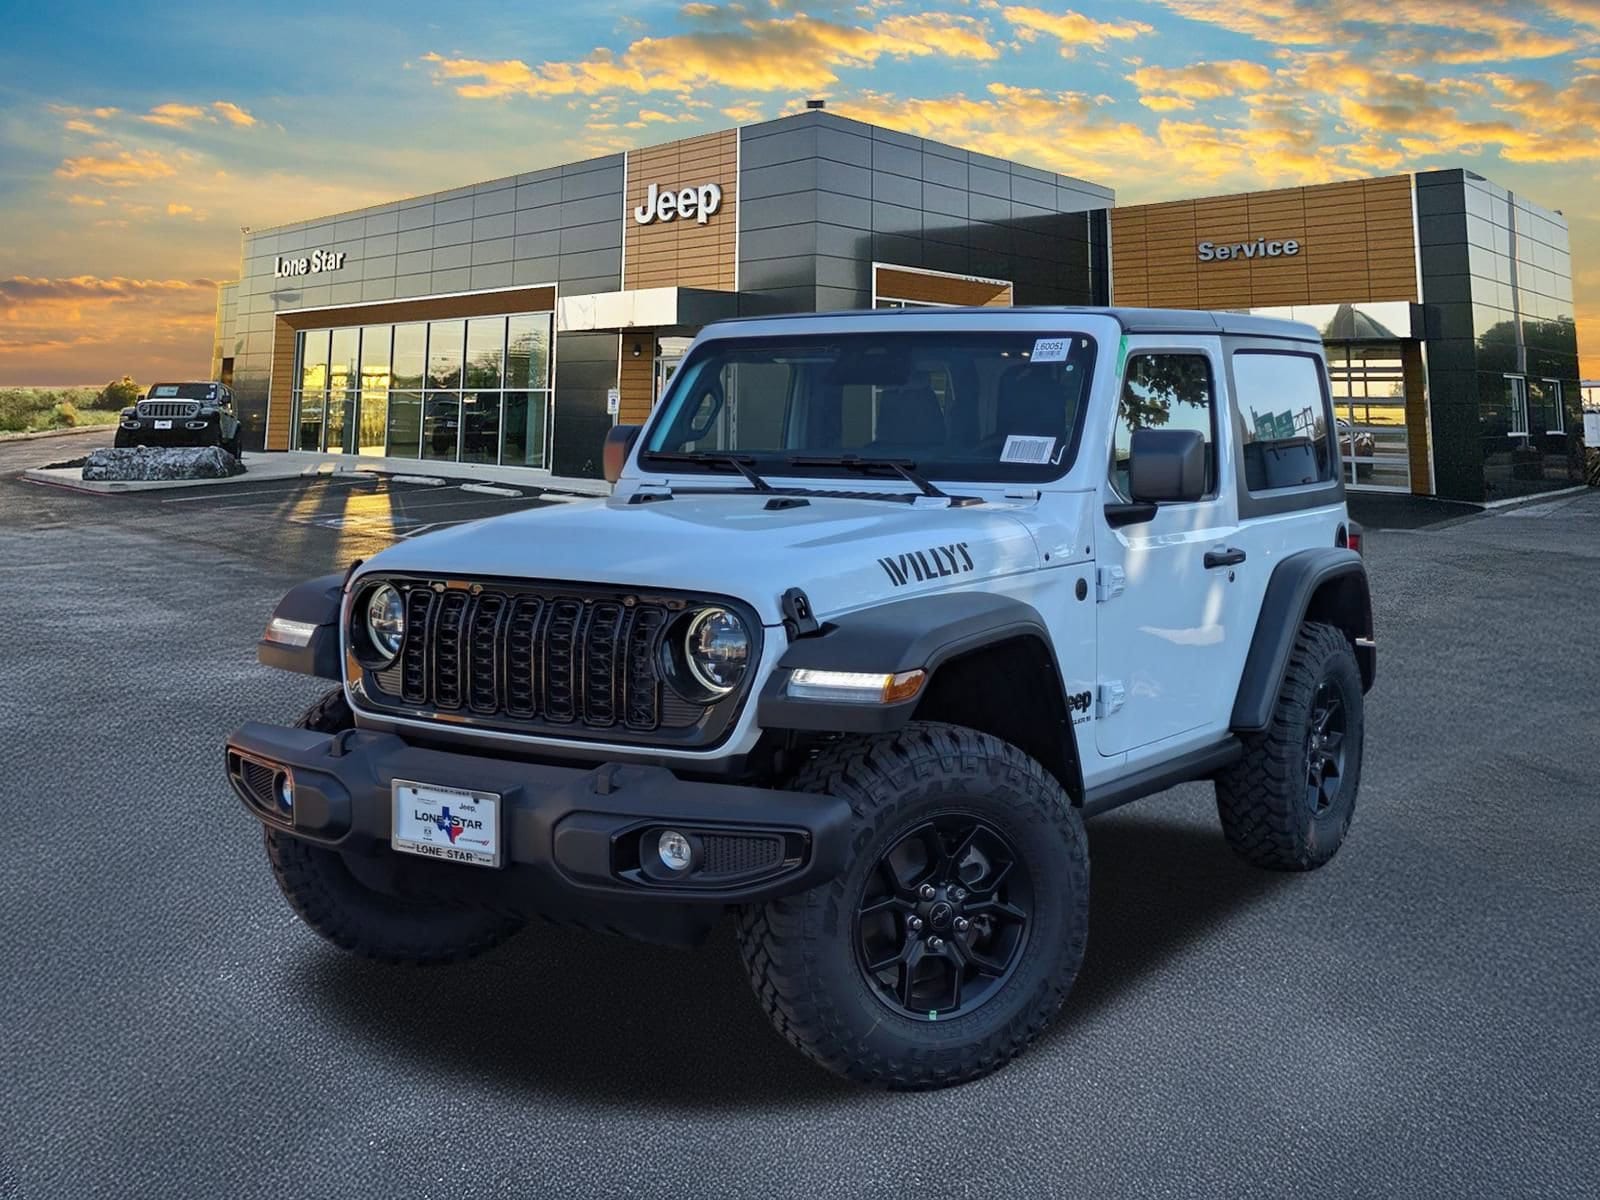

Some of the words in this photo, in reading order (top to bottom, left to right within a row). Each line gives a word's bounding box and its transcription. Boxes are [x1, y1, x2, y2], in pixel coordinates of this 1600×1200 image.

[634, 182, 722, 225] Jeep
[1198, 237, 1300, 261] Service
[274, 256, 309, 278] Lone
[311, 249, 346, 273] Star
[877, 542, 974, 587] WILLYS
[1066, 690, 1092, 713] eep
[415, 809, 443, 823] LONE
[451, 815, 482, 830] STAR
[416, 844, 442, 857] LONE
[447, 849, 473, 861] STAR
